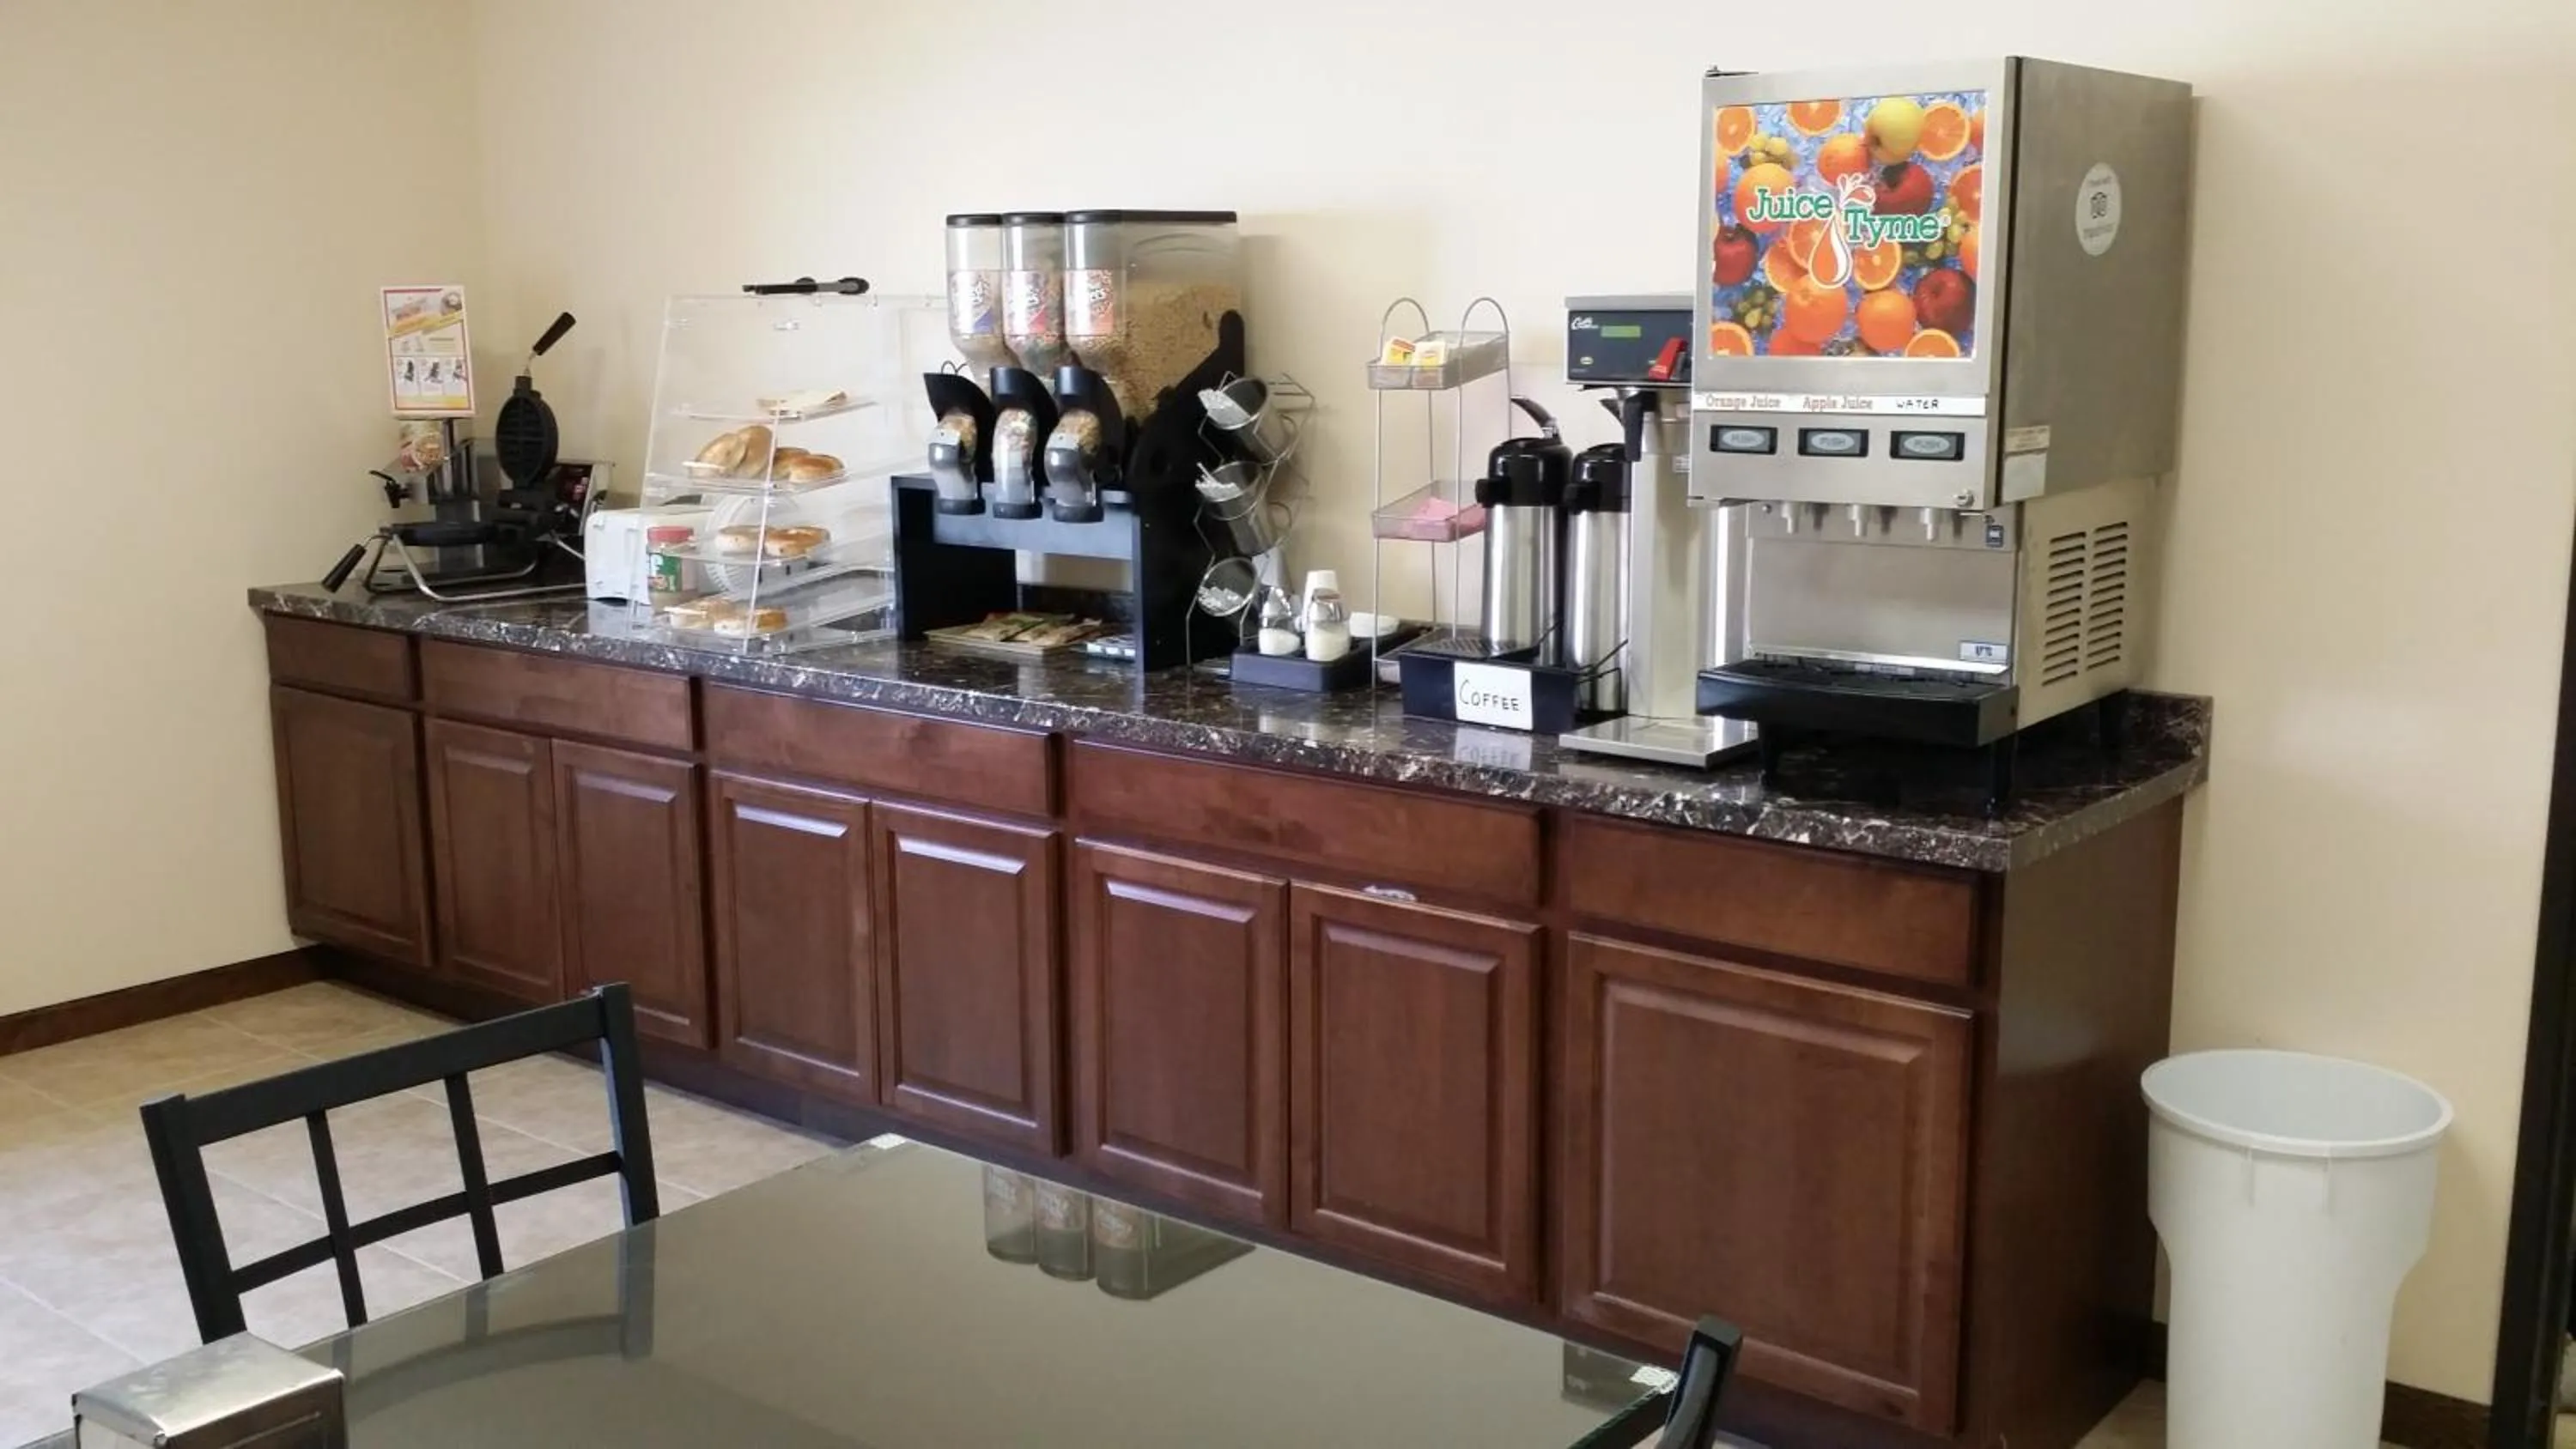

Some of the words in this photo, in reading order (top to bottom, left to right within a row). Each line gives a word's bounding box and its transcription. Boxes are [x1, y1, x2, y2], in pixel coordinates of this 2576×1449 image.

[1748, 187, 1834, 221] Juice
[1844, 208, 1941, 248] Tyme
[1705, 394, 1747, 410] Orange
[1750, 395, 1781, 409] Juice
[1802, 396, 1837, 412] Apple
[1840, 396, 1873, 409] Juice
[1896, 397, 1940, 410] WATER
[1459, 678, 1521, 712] COFFEE
